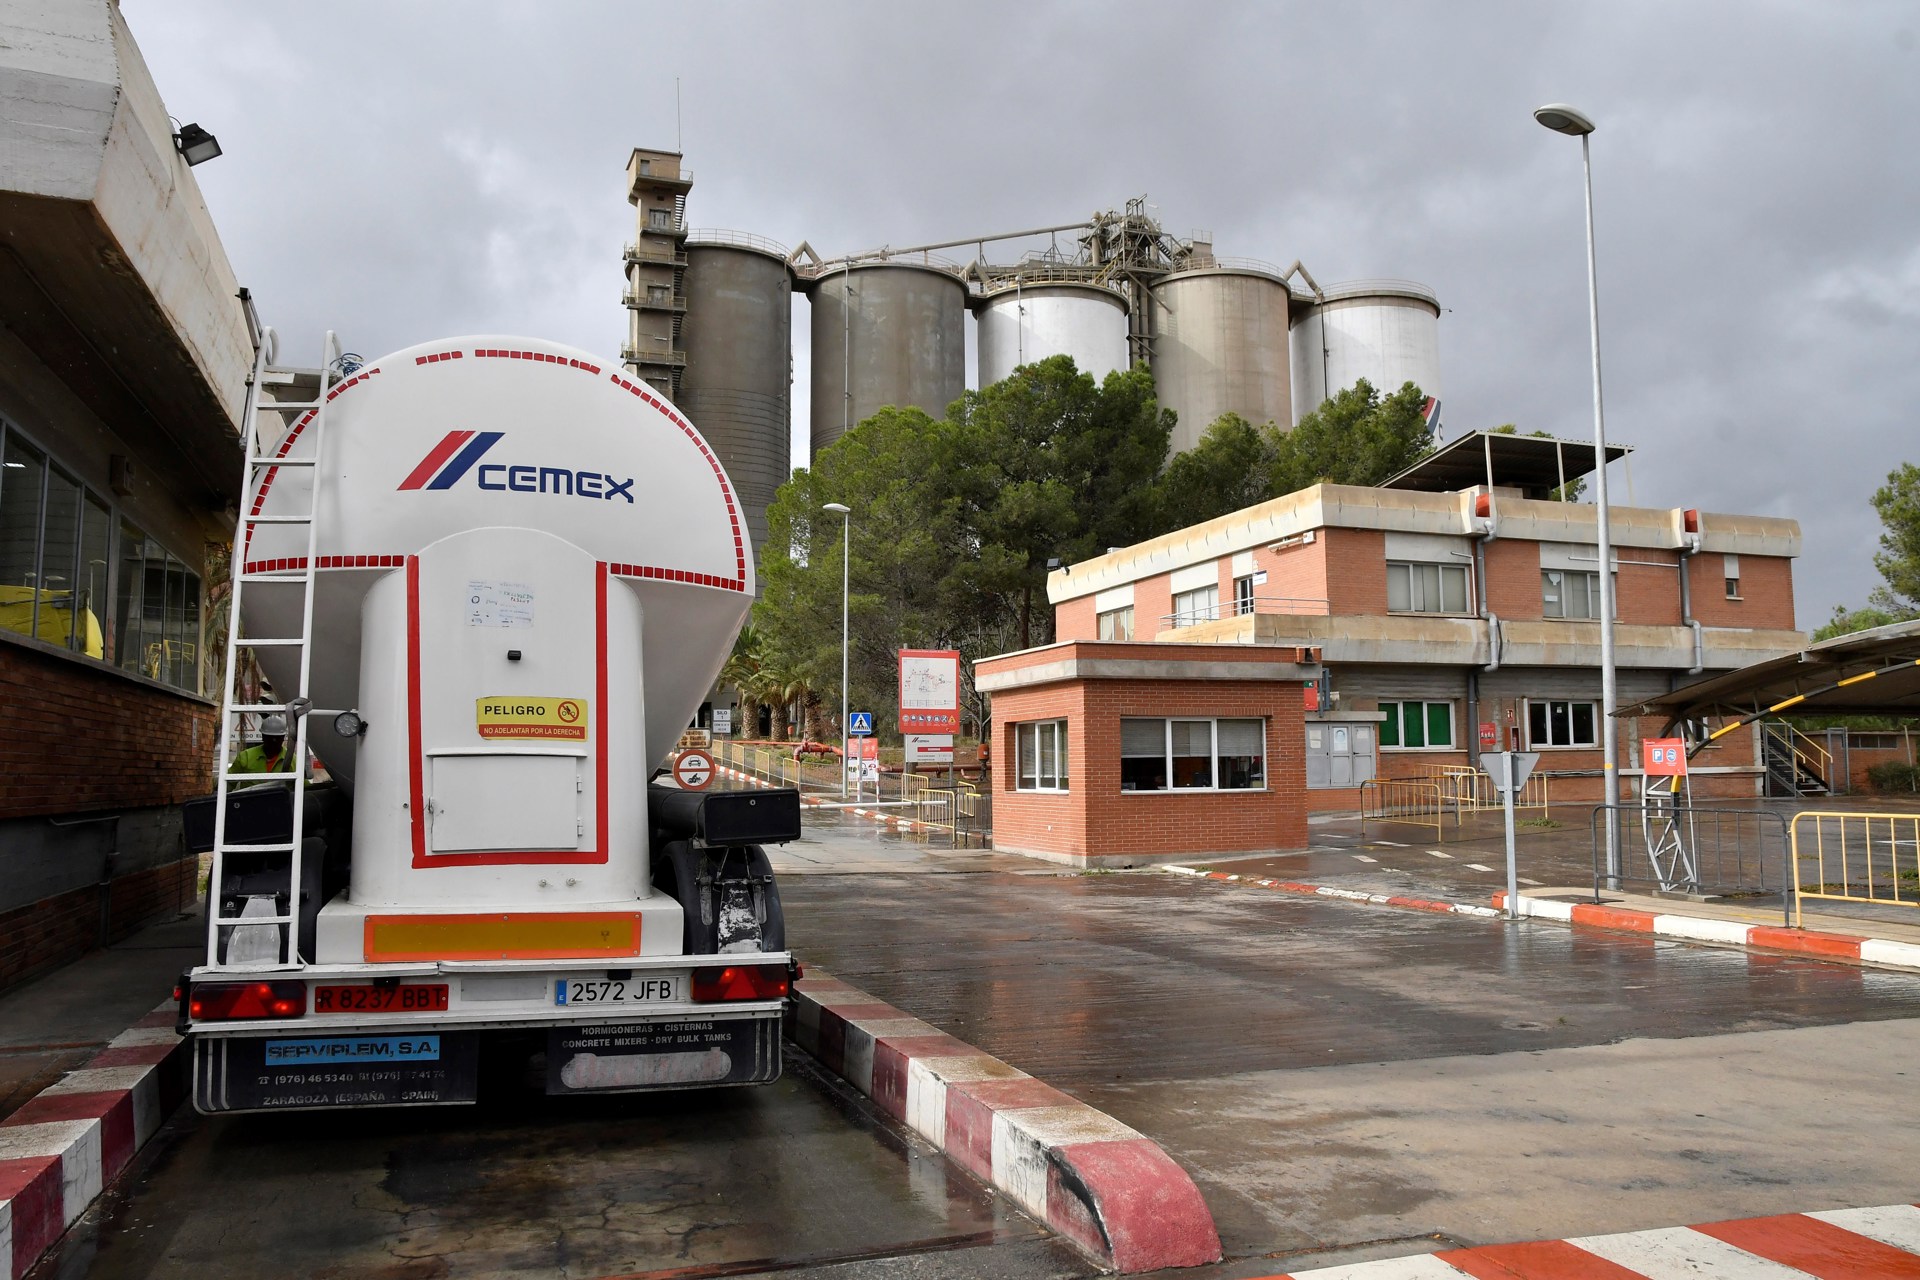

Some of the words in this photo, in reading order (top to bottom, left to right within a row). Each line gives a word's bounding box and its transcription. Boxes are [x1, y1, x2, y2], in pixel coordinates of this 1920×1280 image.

[478, 464, 634, 504] CEMEX
[484, 705, 546, 716] PELIGRO
[494, 727, 530, 735] ADELANTAR
[530, 727, 543, 735] POR
[552, 728, 581, 736] DERECHA
[319, 989, 334, 1009] R
[340, 988, 397, 1009] 8237
[402, 987, 444, 1009] BBT
[571, 981, 625, 1002] 2572
[633, 980, 671, 1001] JFB
[581, 1024, 654, 1036] HORMIGONERAS
[664, 1022, 713, 1033] CISTERNAS
[562, 1038, 611, 1048] CONCRETE
[614, 1037, 648, 1047] MIXERS
[655, 1035, 673, 1045] DRY
[677, 1034, 700, 1044] BULK
[704, 1032, 732, 1042] TANKS
[268, 1043, 394, 1059] SERVIPLEM,
[398, 1041, 438, 1055] S.A.
[275, 1073, 306, 1085] (976)
[262, 1094, 329, 1106] ZARAGOZA
[335, 1090, 385, 1104] (ESPAÑA
[401, 1090, 439, 1101] SPAIN)
